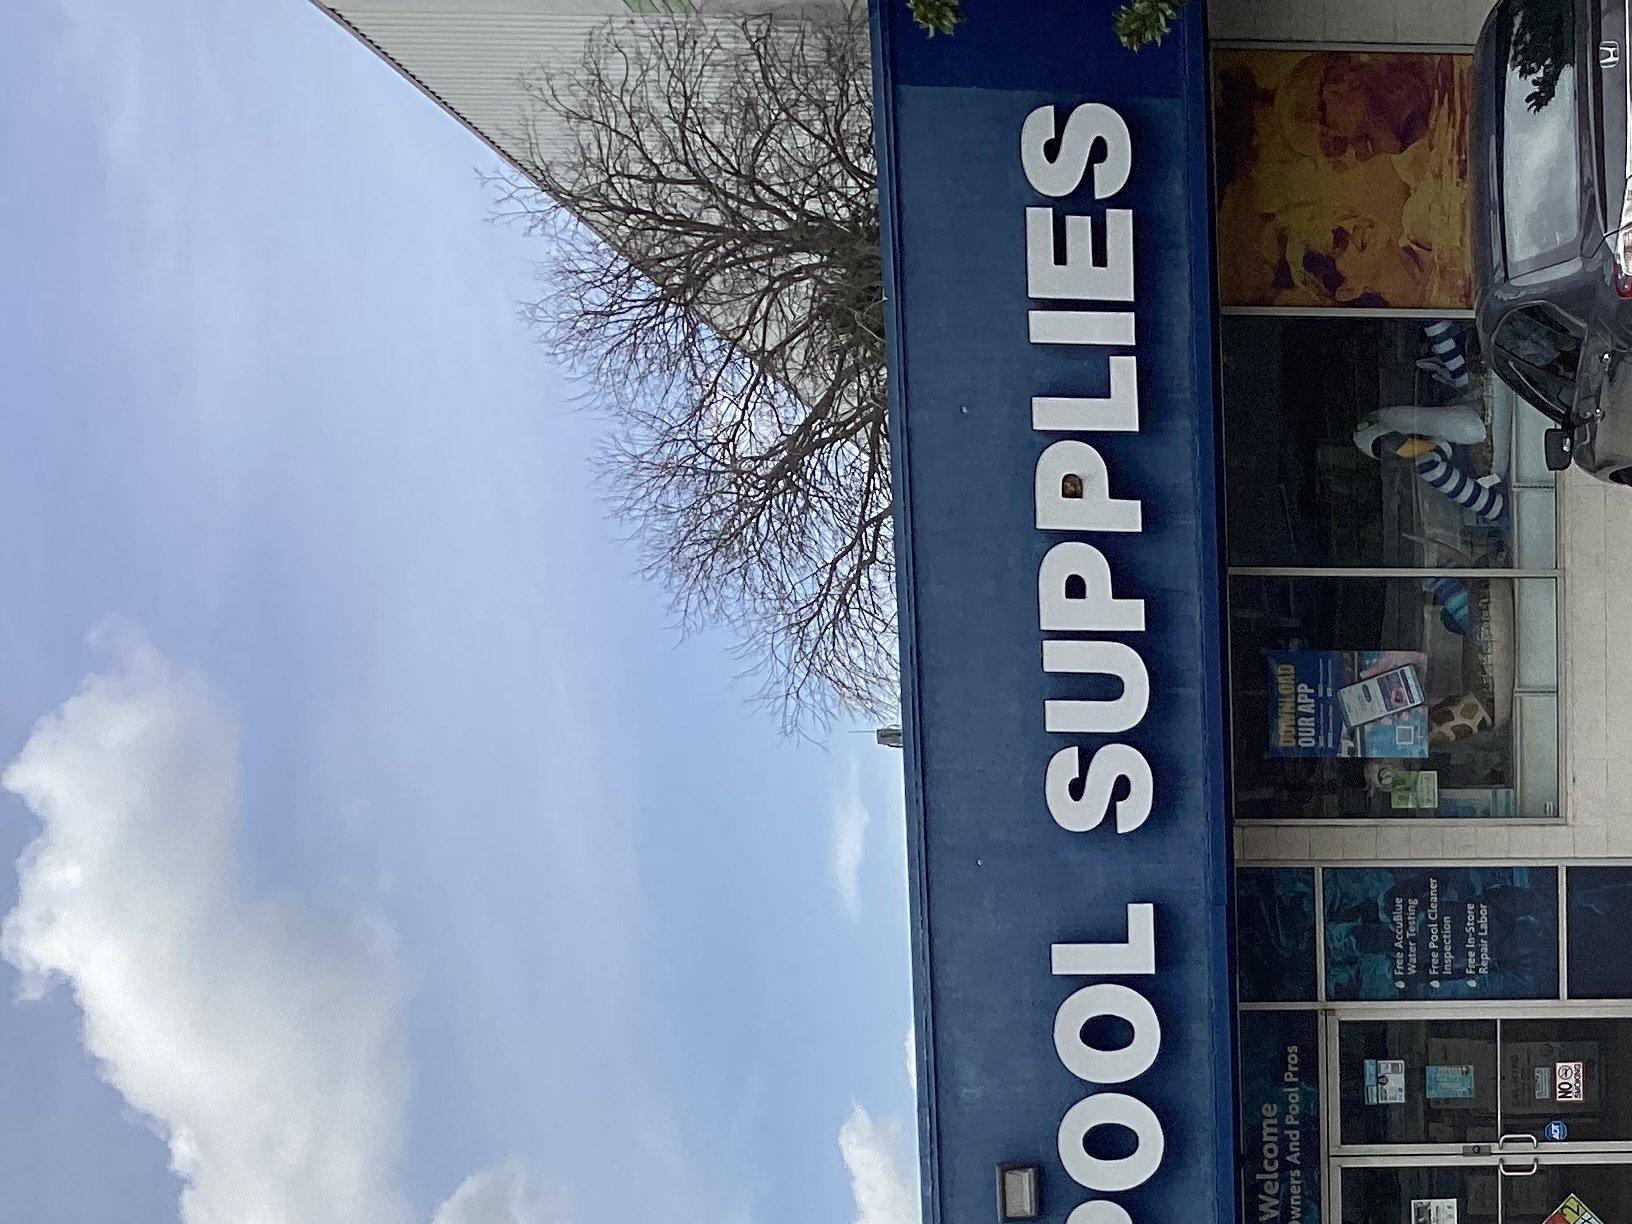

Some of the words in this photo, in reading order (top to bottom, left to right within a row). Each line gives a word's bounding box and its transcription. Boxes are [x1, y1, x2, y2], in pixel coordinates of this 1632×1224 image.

[1021, 102, 1154, 834] SUPPLIES
[1277, 664, 1295, 747] DOWNLOAD
[1297, 683, 1315, 714] APP
[1298, 717, 1315, 747] OUR
[1427, 877, 1438, 920] Cleaner
[1392, 897, 1404, 949] AccuBlue
[1406, 898, 1419, 938] Testing
[1427, 923, 1439, 949] Pool
[1464, 903, 1476, 948] In-Store
[1476, 903, 1488, 936] Labor
[1394, 952, 1404, 975] Free
[1407, 941, 1417, 975] Water
[1429, 952, 1439, 975] Free
[1441, 916, 1454, 975] Inspection
[1465, 951, 1476, 975] Free
[1478, 938, 1491, 974] Repair
[1283, 1045, 1299, 1082] Pros
[1573, 1063, 1582, 1099] SMOKING
[1283, 1087, 1300, 1125] Pool
[1557, 1081, 1573, 1099] NO
[1284, 1129, 1301, 1165] And
[1551, 1123, 1560, 1141] ADT
[1256, 1103, 1280, 1222] Welcome
[1561, 1204, 1580, 1217] 2
